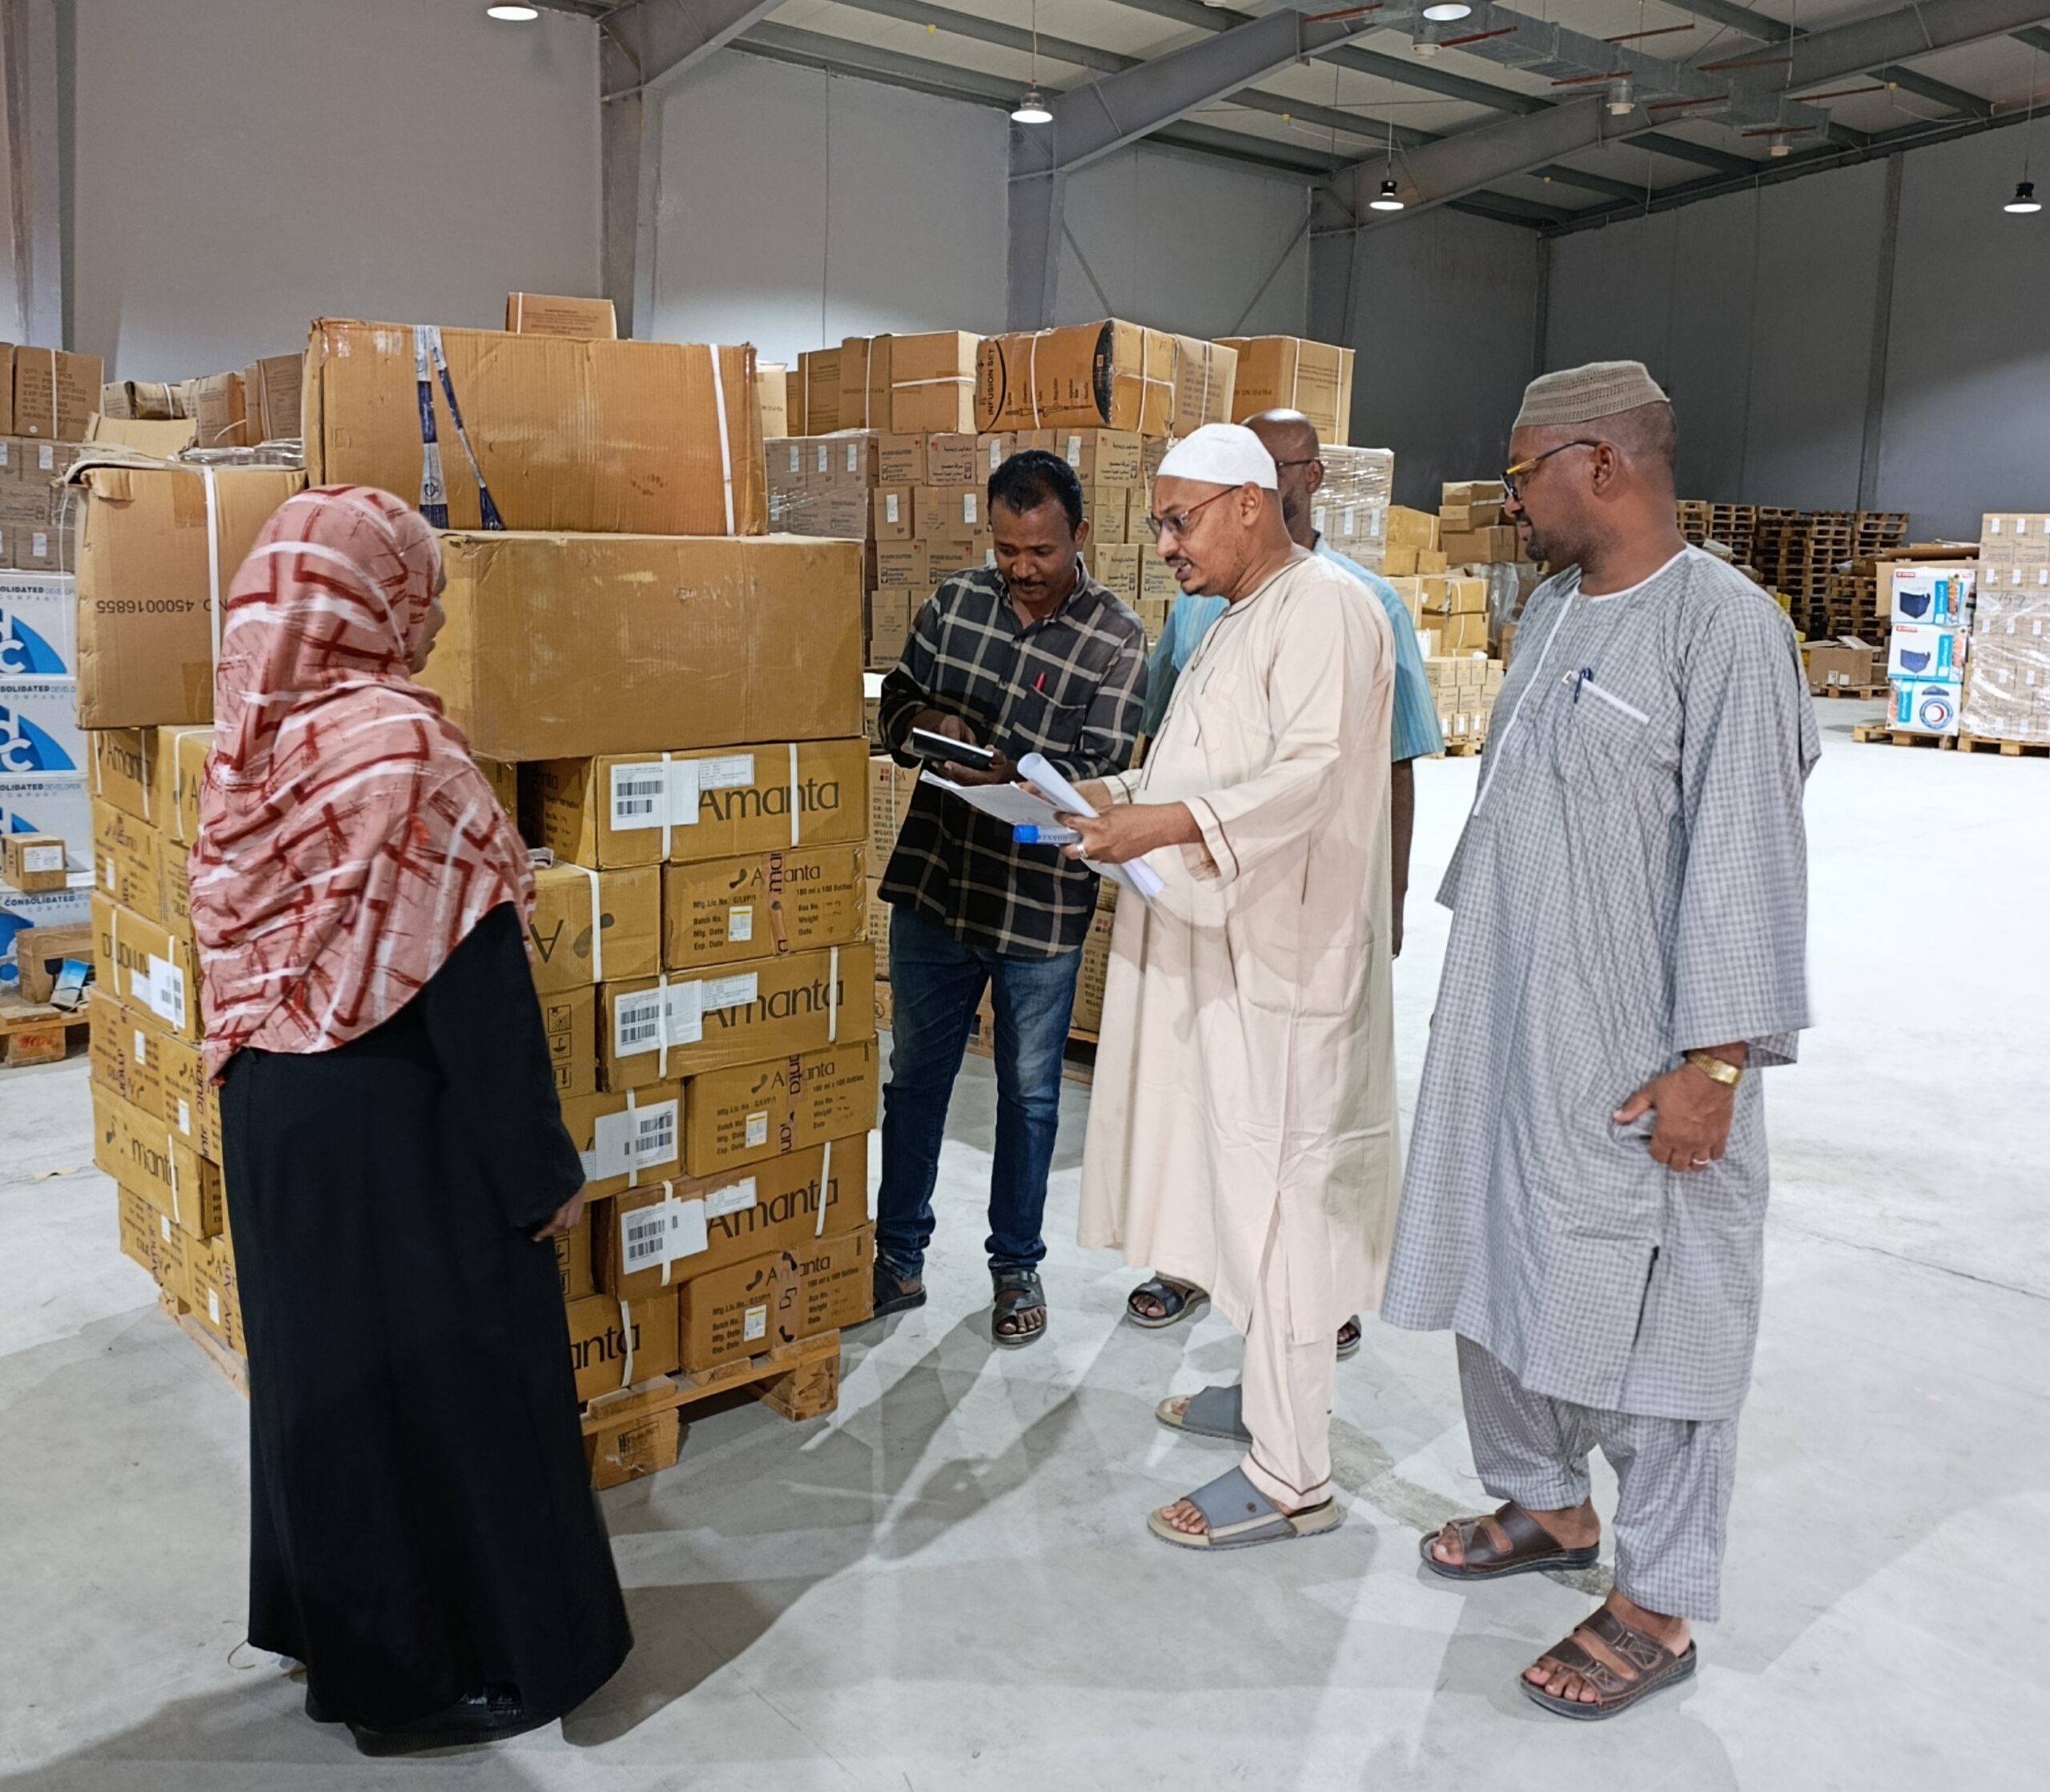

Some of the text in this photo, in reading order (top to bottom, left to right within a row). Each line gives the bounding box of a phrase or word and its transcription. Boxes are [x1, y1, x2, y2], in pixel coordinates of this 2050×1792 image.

[987, 369, 995, 415] INFUSION
[96, 599, 195, 614] 4500016855
[698, 777, 839, 822] Amanta
[751, 865, 820, 886] Aanta
[4, 894, 75, 906] CONSOLIDATED
[798, 914, 818, 924] Weight
[709, 927, 723, 936] Date
[709, 940, 723, 949] Date
